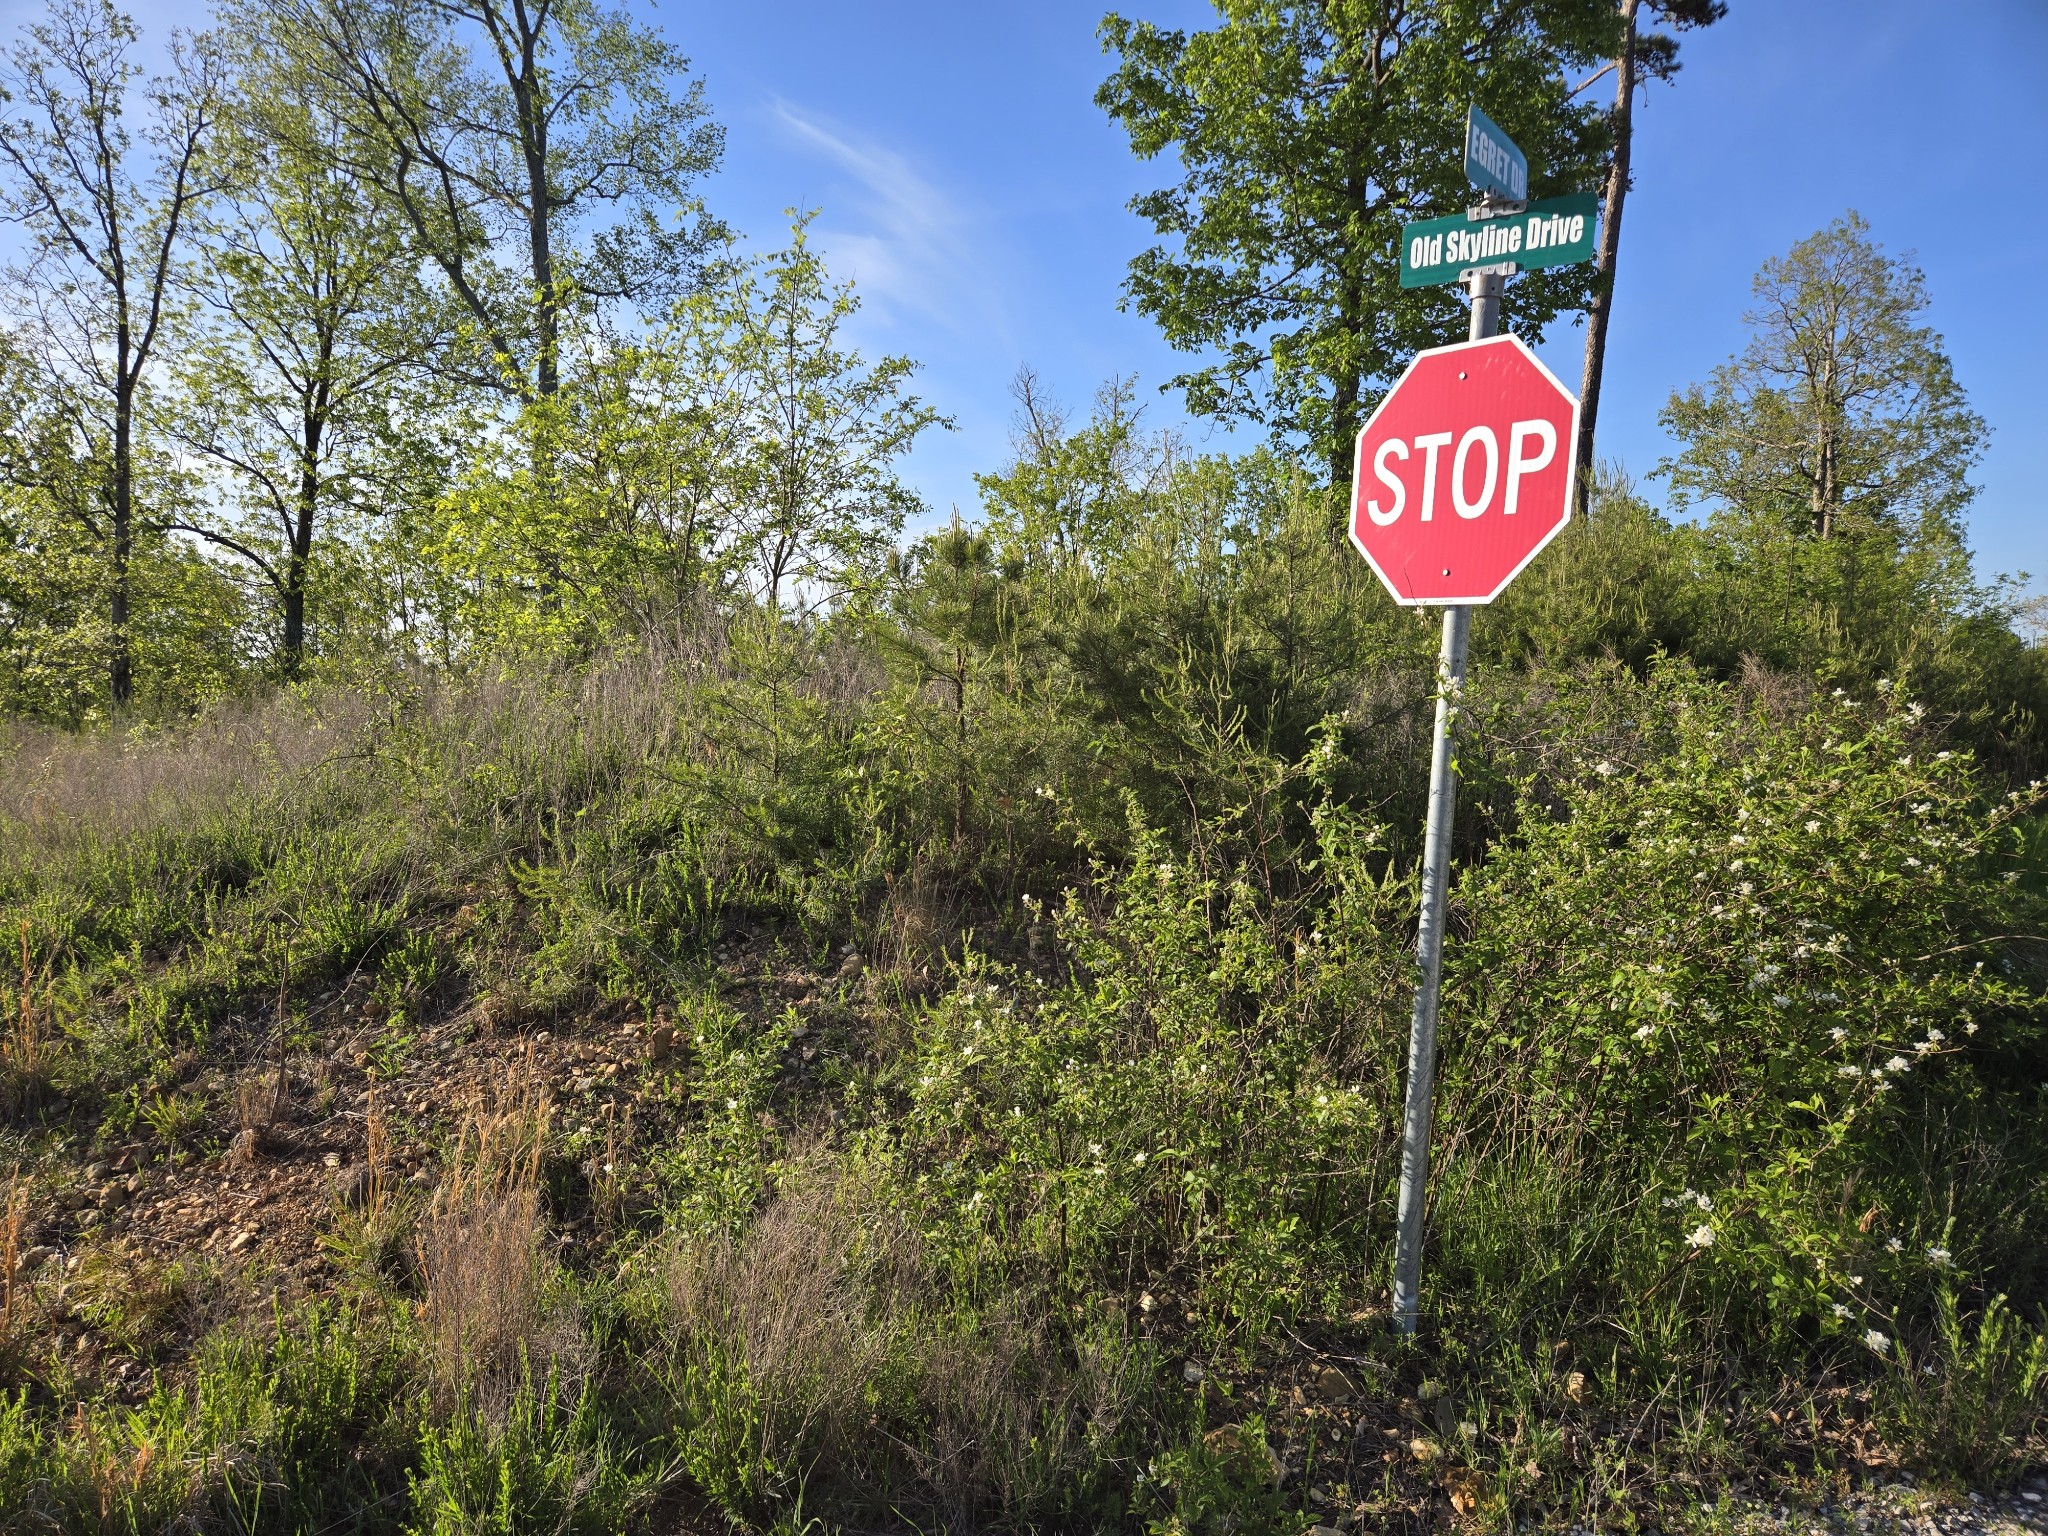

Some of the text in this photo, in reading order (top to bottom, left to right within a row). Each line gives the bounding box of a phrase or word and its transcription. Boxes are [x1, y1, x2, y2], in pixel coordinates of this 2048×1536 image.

[1471, 124, 1524, 200] EGRET DR
[1410, 214, 1584, 269] Old Skyline Drive
[1367, 419, 1557, 526] STOP
